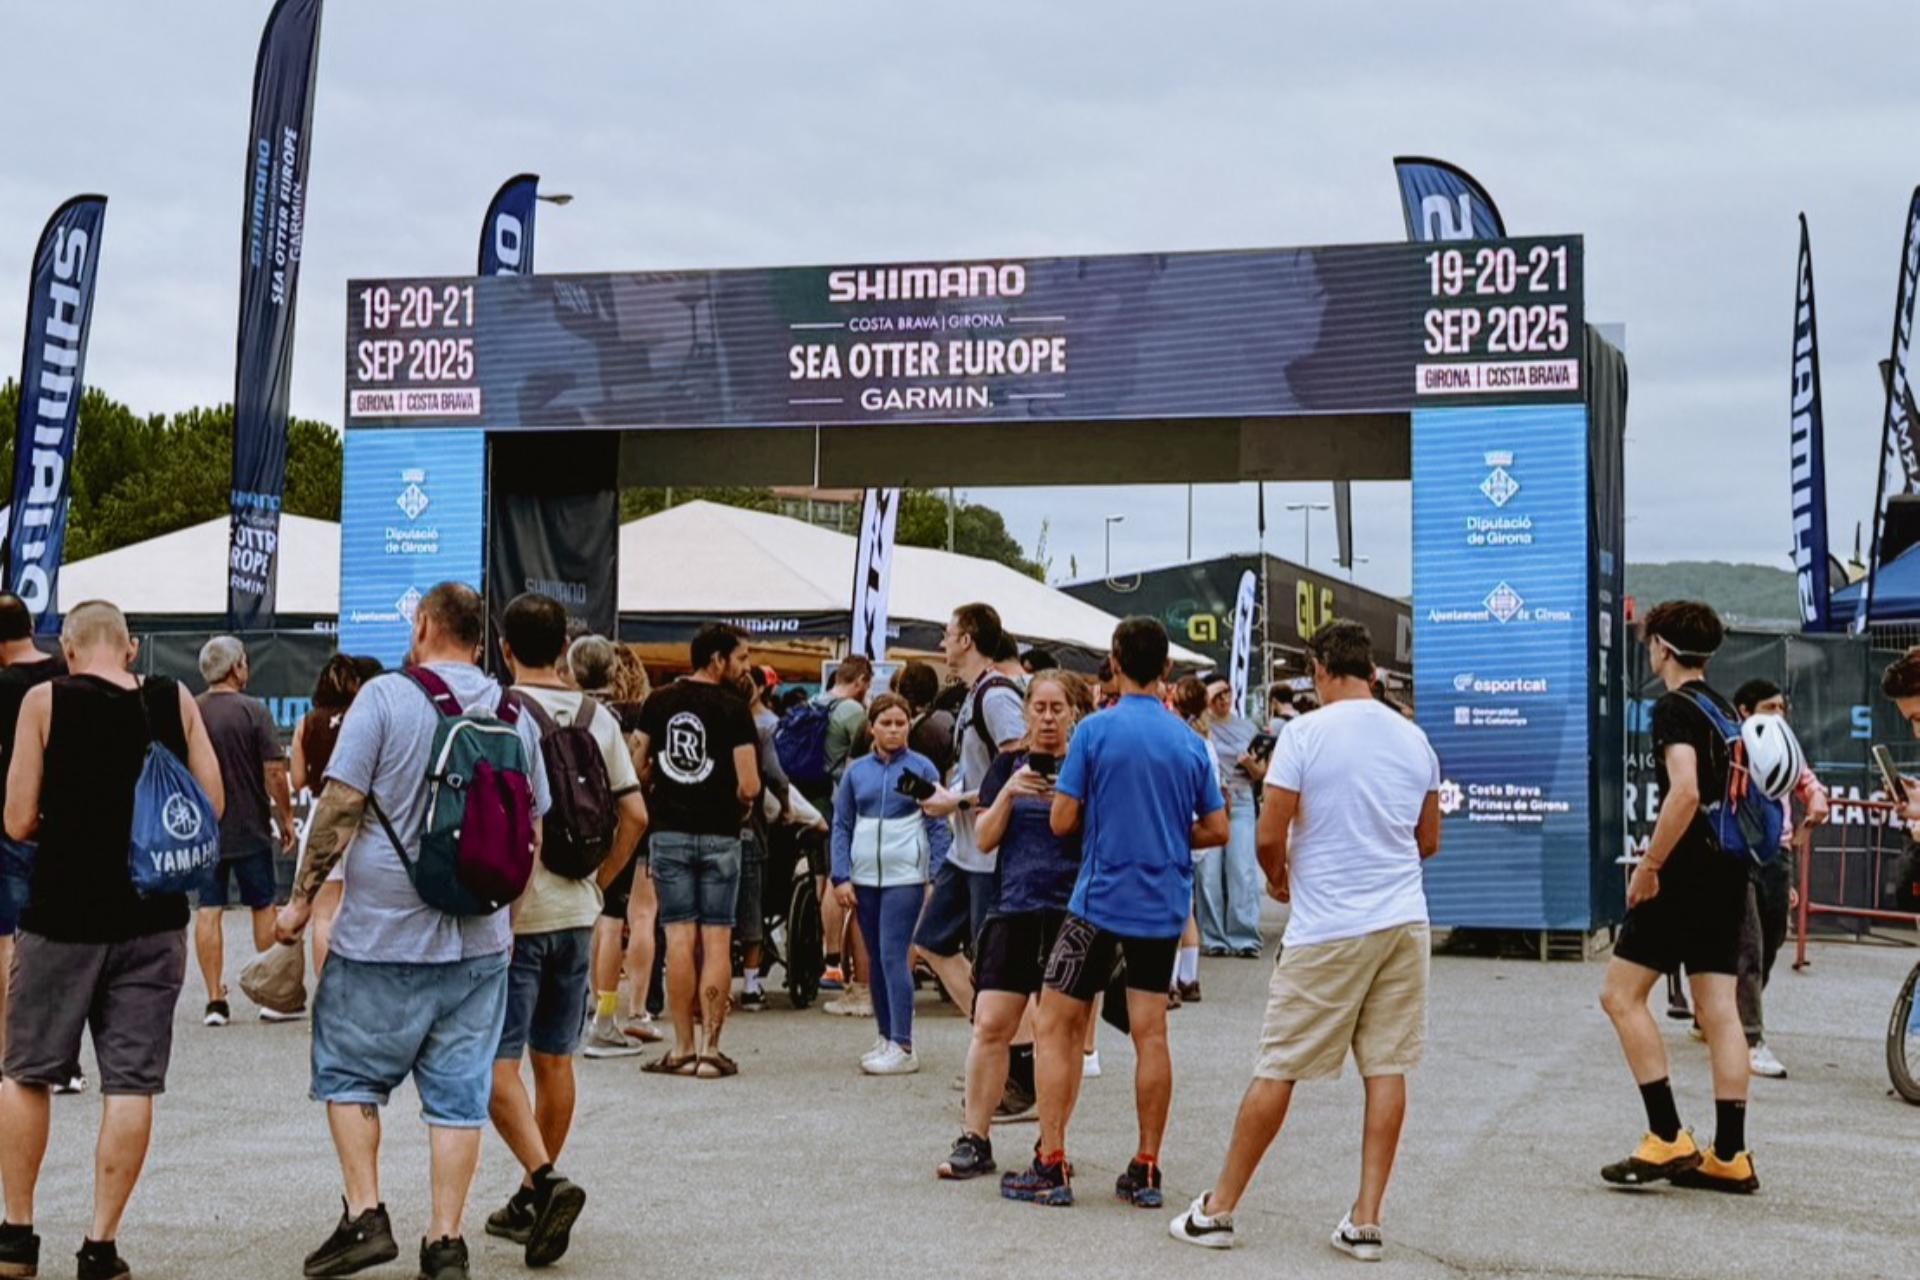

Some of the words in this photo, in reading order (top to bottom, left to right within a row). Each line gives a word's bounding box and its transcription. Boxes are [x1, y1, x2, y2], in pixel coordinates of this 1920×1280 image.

[281, 126, 297, 202] EUROPE
[251, 138, 271, 268] SHIMANO
[275, 206, 289, 266] OTTER
[271, 270, 284, 305] SEA
[827, 264, 1026, 302] SHIMANO
[1425, 245, 1568, 297] 19-20-21
[360, 285, 474, 329] 19-20-21
[849, 316, 894, 332] COSTA
[897, 315, 938, 330] BRAVA
[948, 314, 1004, 329] GIRONA
[1423, 307, 1481, 355] SEP
[1487, 304, 1569, 353] 2025
[357, 339, 404, 382] SEP
[408, 338, 474, 381] 2025
[788, 344, 842, 380] SEA
[849, 341, 940, 379] OTTER
[948, 337, 1067, 376] EUROPE
[1424, 368, 1471, 389] GIRONA
[1486, 367, 1526, 388] COSTA
[1529, 365, 1570, 386] BRAVA
[356, 394, 394, 412] GIRONA
[407, 393, 439, 411] COSTA
[441, 392, 474, 410] BRAVA
[17, 226, 88, 615] SHIMANO
[385, 527, 439, 541] Diputació
[1467, 514, 1532, 531] Diputació
[1467, 533, 1485, 545] de
[1487, 532, 1532, 545] Girona
[385, 541, 399, 553] de
[401, 541, 438, 553] Girona
[1428, 609, 1489, 623] Ajuntament
[1534, 608, 1571, 621] Girona
[1473, 678, 1547, 694] esportcat
[1468, 784, 1503, 796] Costa
[1505, 784, 1541, 797] Brava
[1468, 798, 1511, 811] Pirineu
[1513, 798, 1528, 811] de
[1530, 799, 1569, 812] Girona
[150, 838, 219, 872] YAMAH
